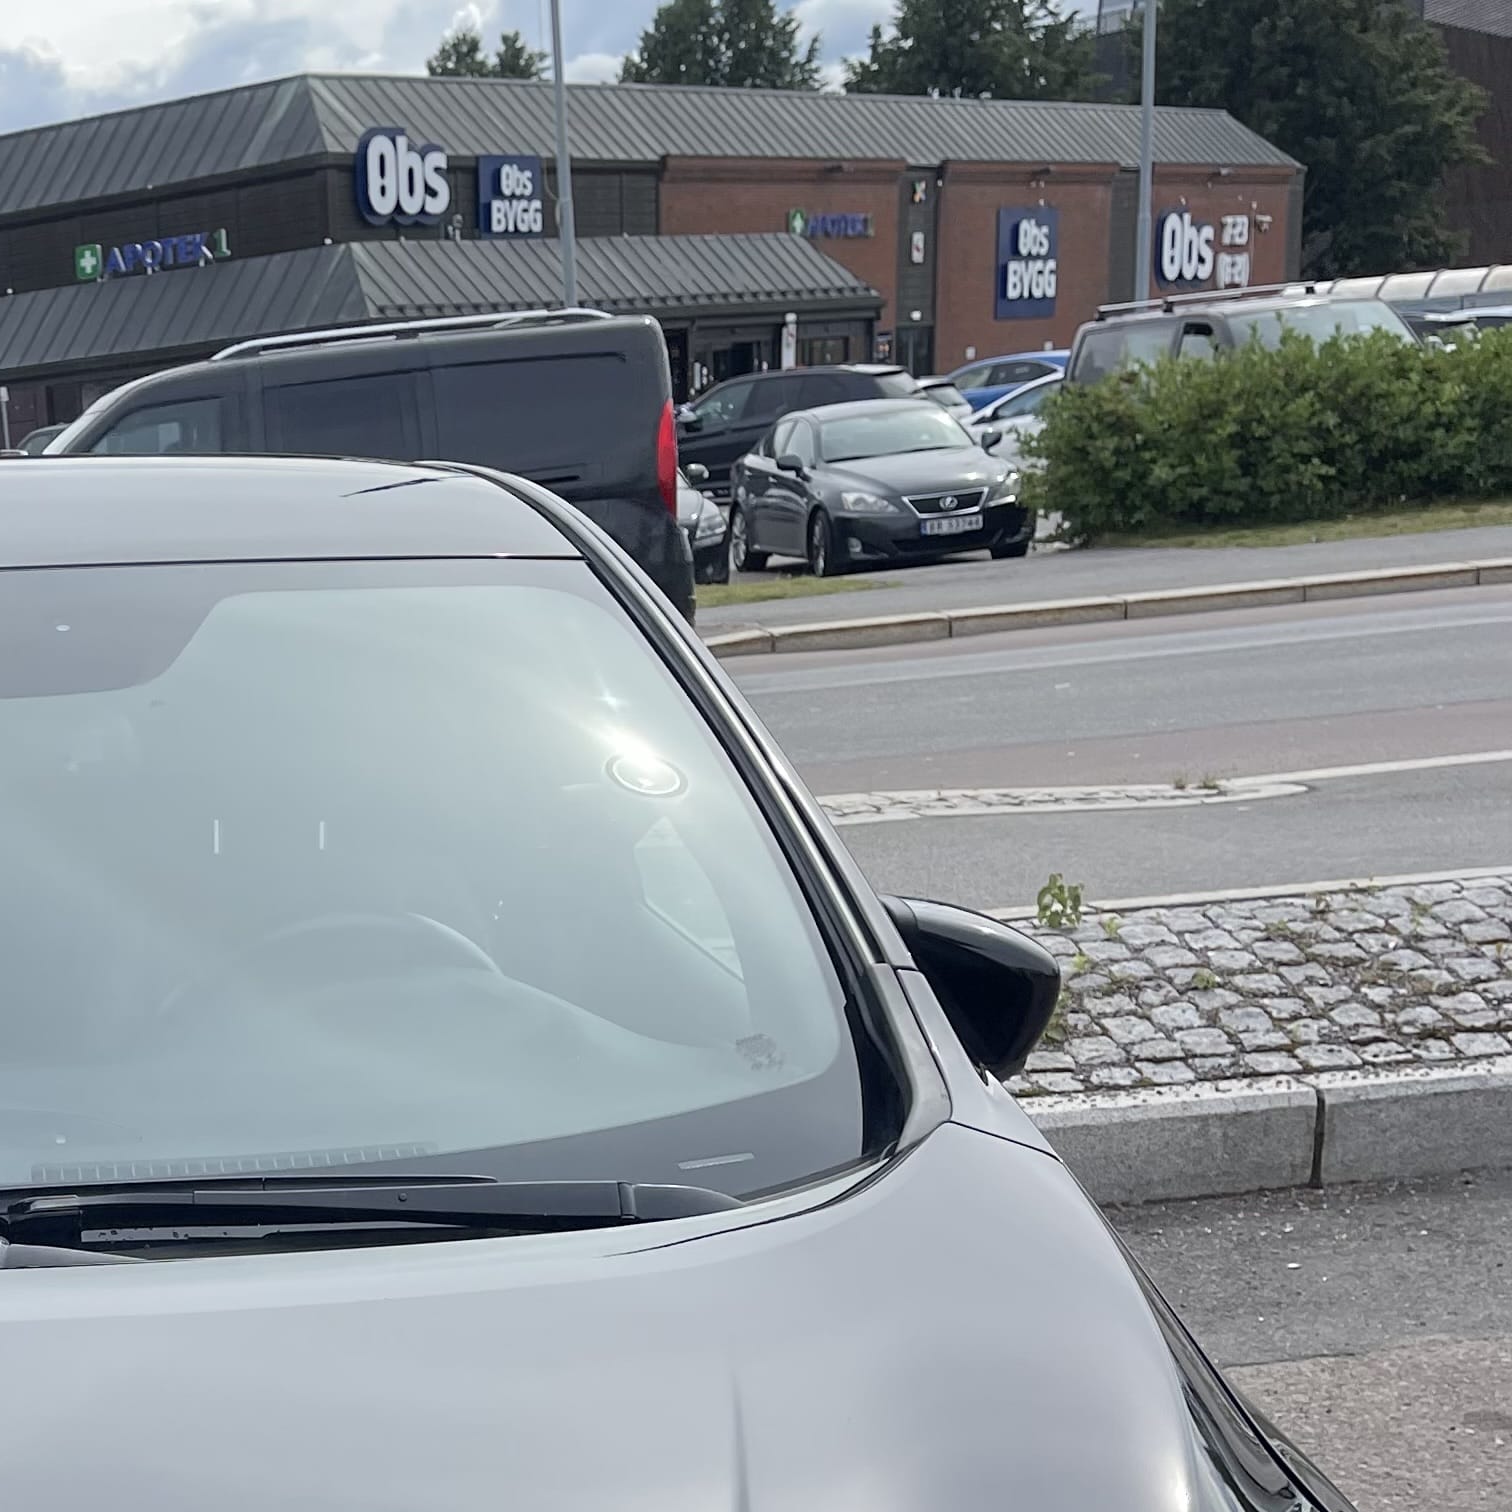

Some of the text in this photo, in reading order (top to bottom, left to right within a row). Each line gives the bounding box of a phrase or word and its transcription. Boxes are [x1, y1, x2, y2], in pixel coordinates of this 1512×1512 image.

[367, 135, 450, 215] Obs
[500, 164, 533, 196] Obs
[491, 200, 543, 232] BYGG
[105, 232, 213, 273] APOTEK
[1018, 219, 1049, 256] Obs
[1162, 212, 1215, 281] Obs
[1007, 259, 1057, 299] BYGG
